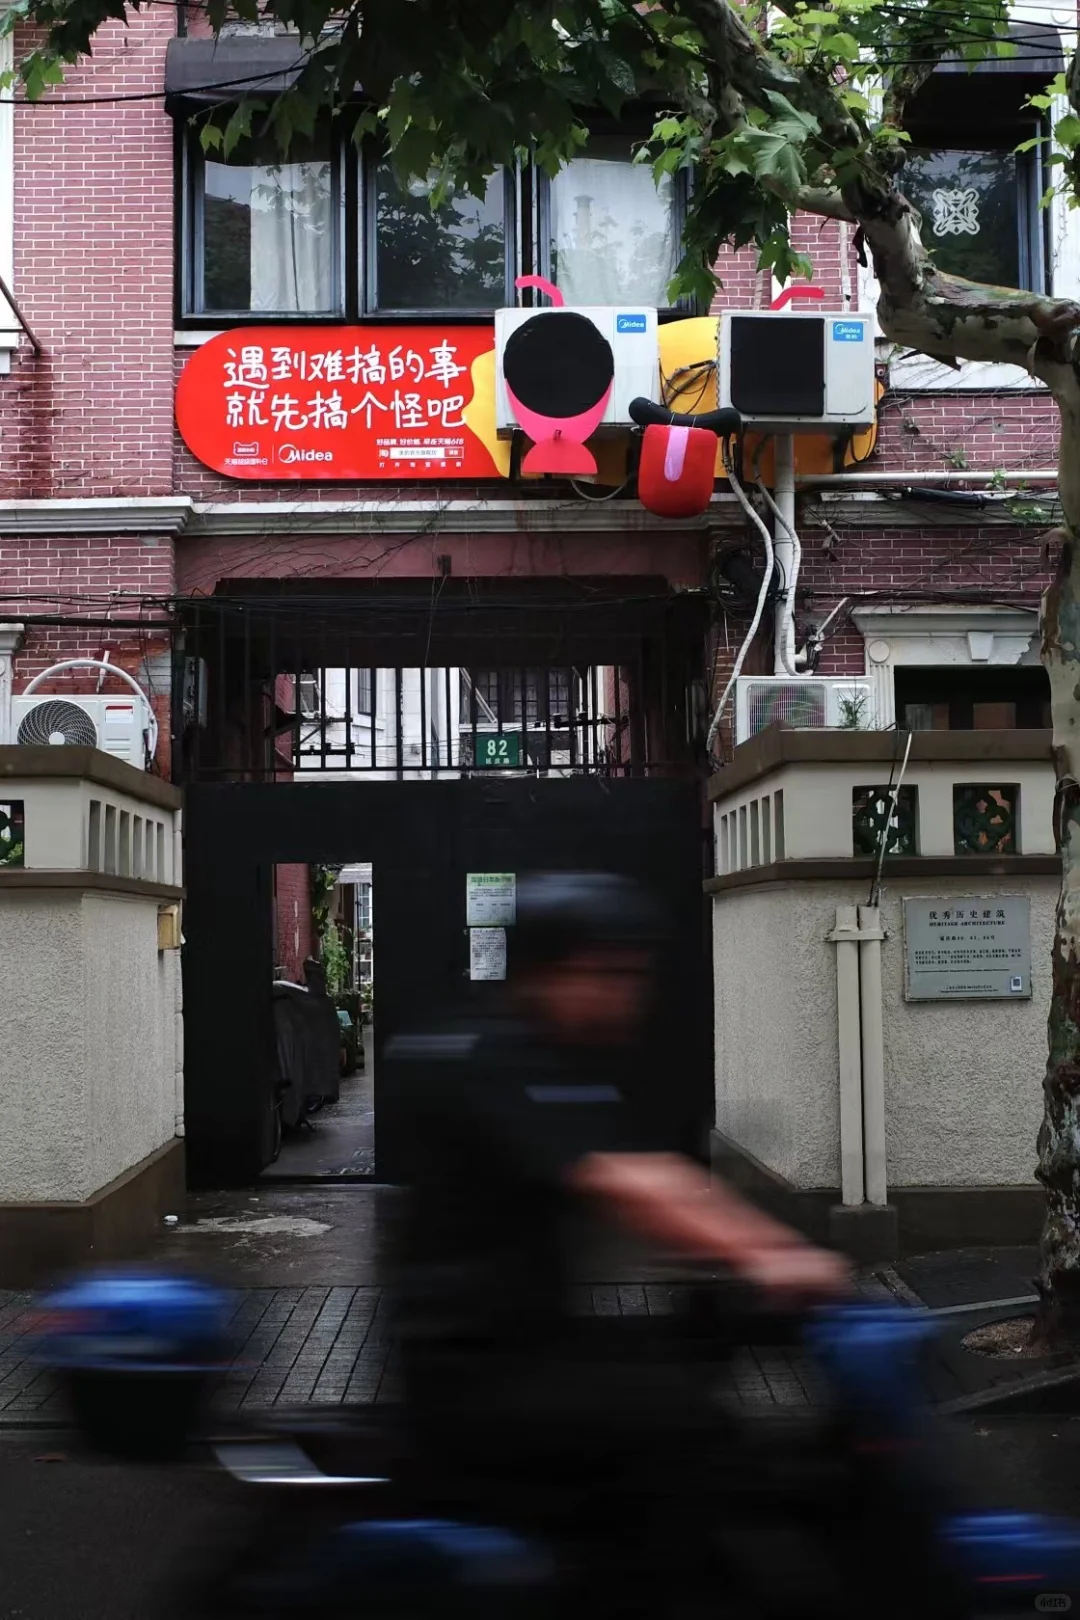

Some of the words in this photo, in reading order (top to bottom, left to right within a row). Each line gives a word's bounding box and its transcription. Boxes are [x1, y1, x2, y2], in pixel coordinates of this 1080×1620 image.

[618, 318, 645, 329] Midea
[834, 323, 861, 335] Midea
[223, 339, 467, 390] 遇到难搞的事
[225, 388, 468, 431] 就先搞个怪吧
[279, 443, 333, 464] Midea
[487, 739, 508, 756] 82
[928, 909, 1006, 920] 优秀历史建筑
